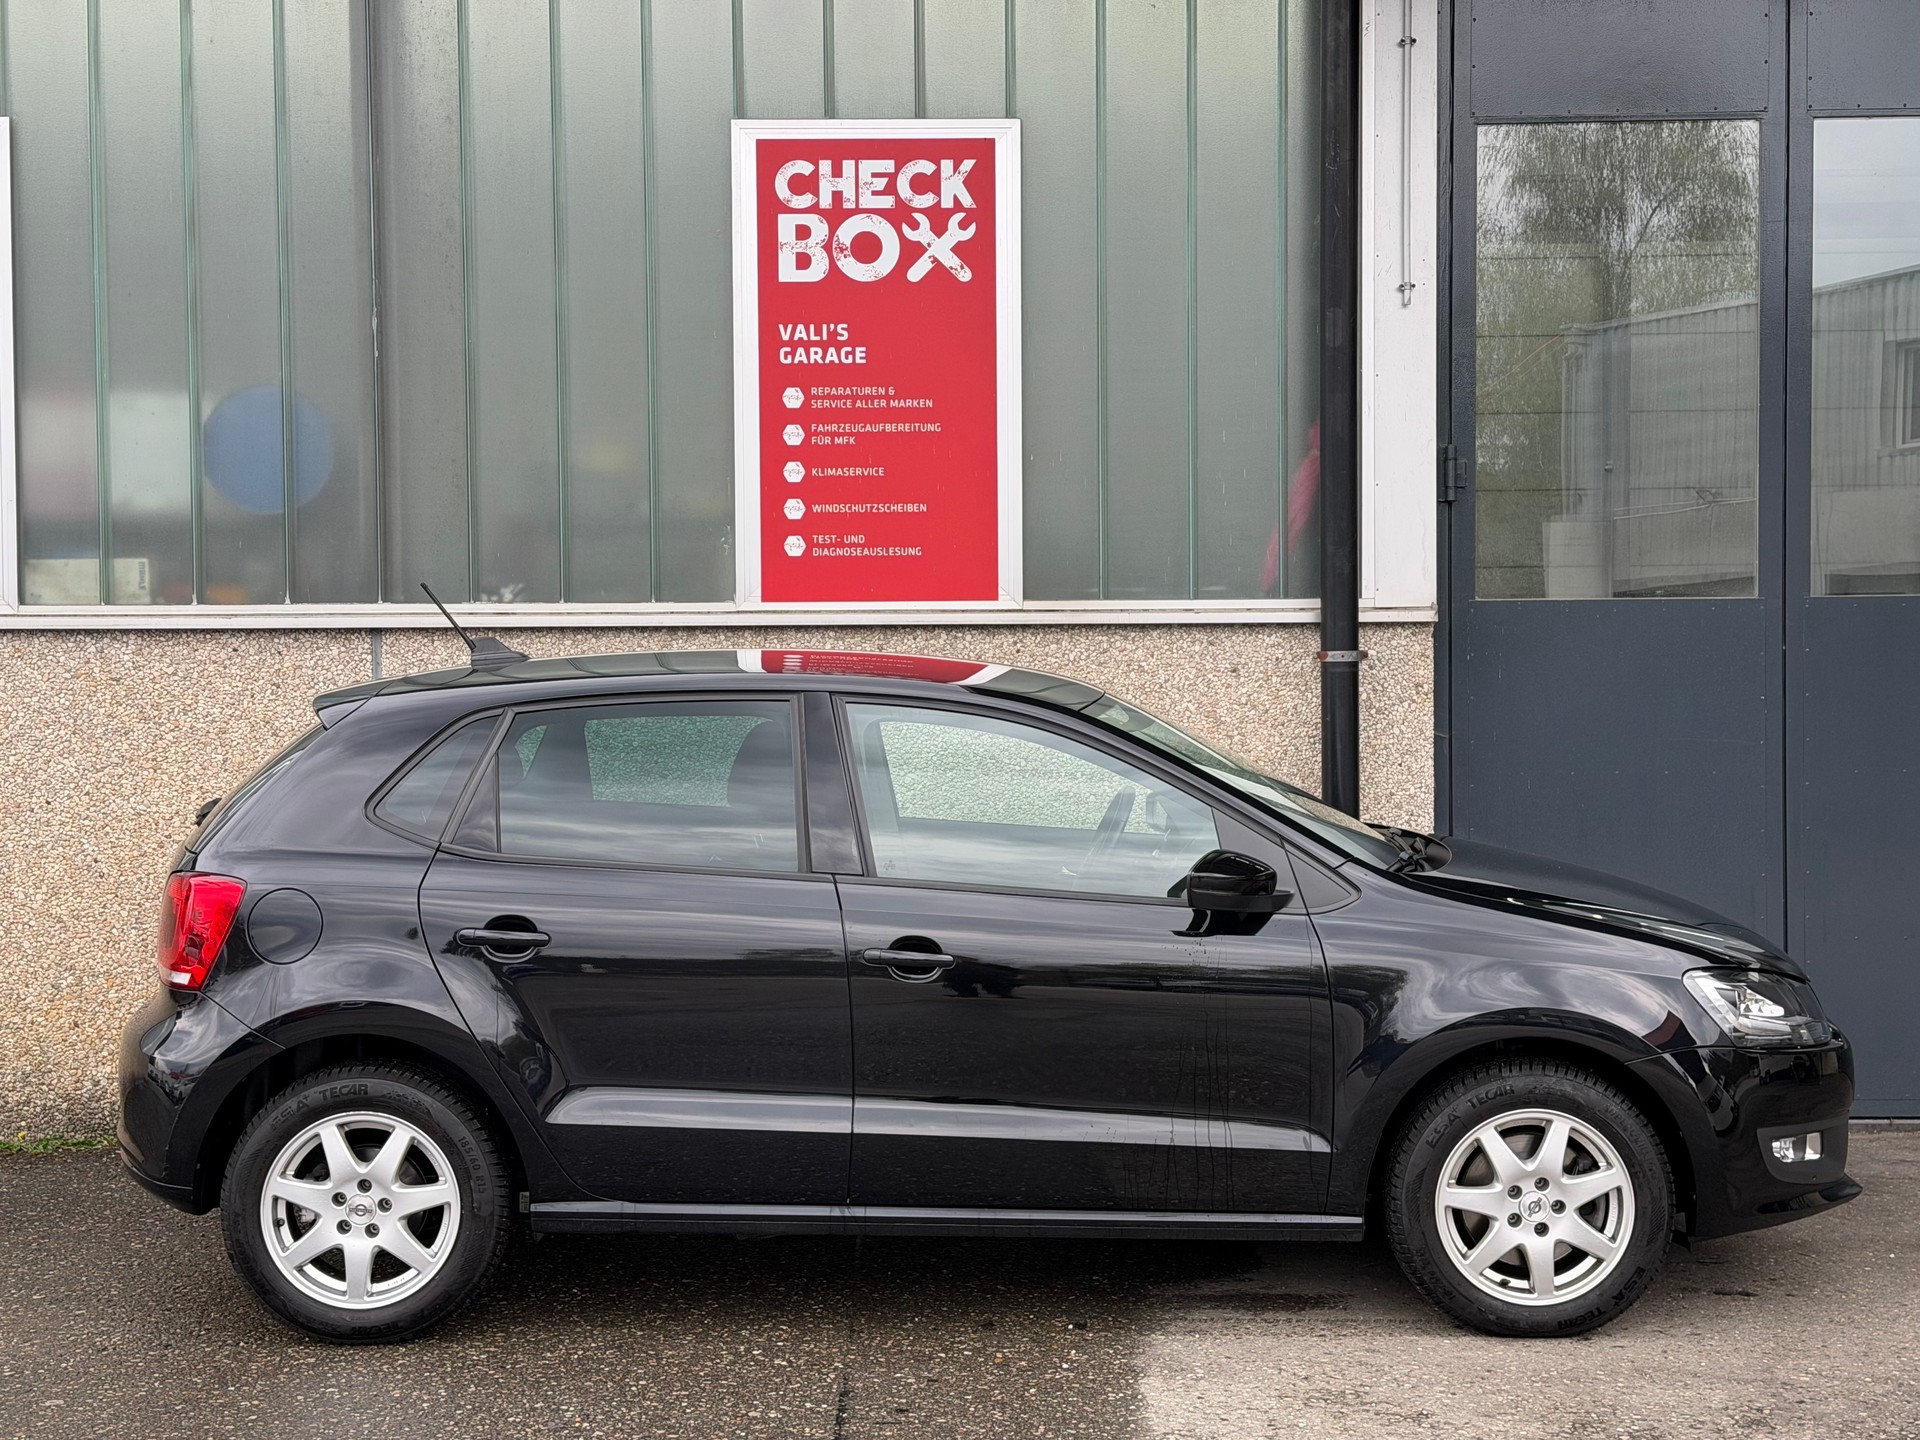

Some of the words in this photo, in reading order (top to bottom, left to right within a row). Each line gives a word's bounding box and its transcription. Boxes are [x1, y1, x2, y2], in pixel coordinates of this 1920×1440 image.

[775, 159, 976, 209] CHECK
[780, 347, 866, 364] GARAGE
[810, 386, 886, 396] REPARATUREN
[888, 387, 896, 396] &
[810, 399, 853, 409] SERVICE
[855, 399, 887, 409] ALLER
[889, 398, 933, 408] MARKEN
[811, 422, 942, 433] FAHRZEUGAUFBEREITUNG
[811, 434, 832, 445] FÜR
[834, 435, 856, 445] MFK
[811, 467, 885, 477] KLIMASERVICE
[811, 503, 927, 513] WINDSCHUTZSCHEIBEN
[812, 534, 841, 544] TEST-
[843, 534, 865, 544] UND
[812, 546, 922, 557] DIAGNOSEAUSLESUNG
[318, 1083, 369, 1102] TECAR
[457, 1135, 481, 1171] 185/60
